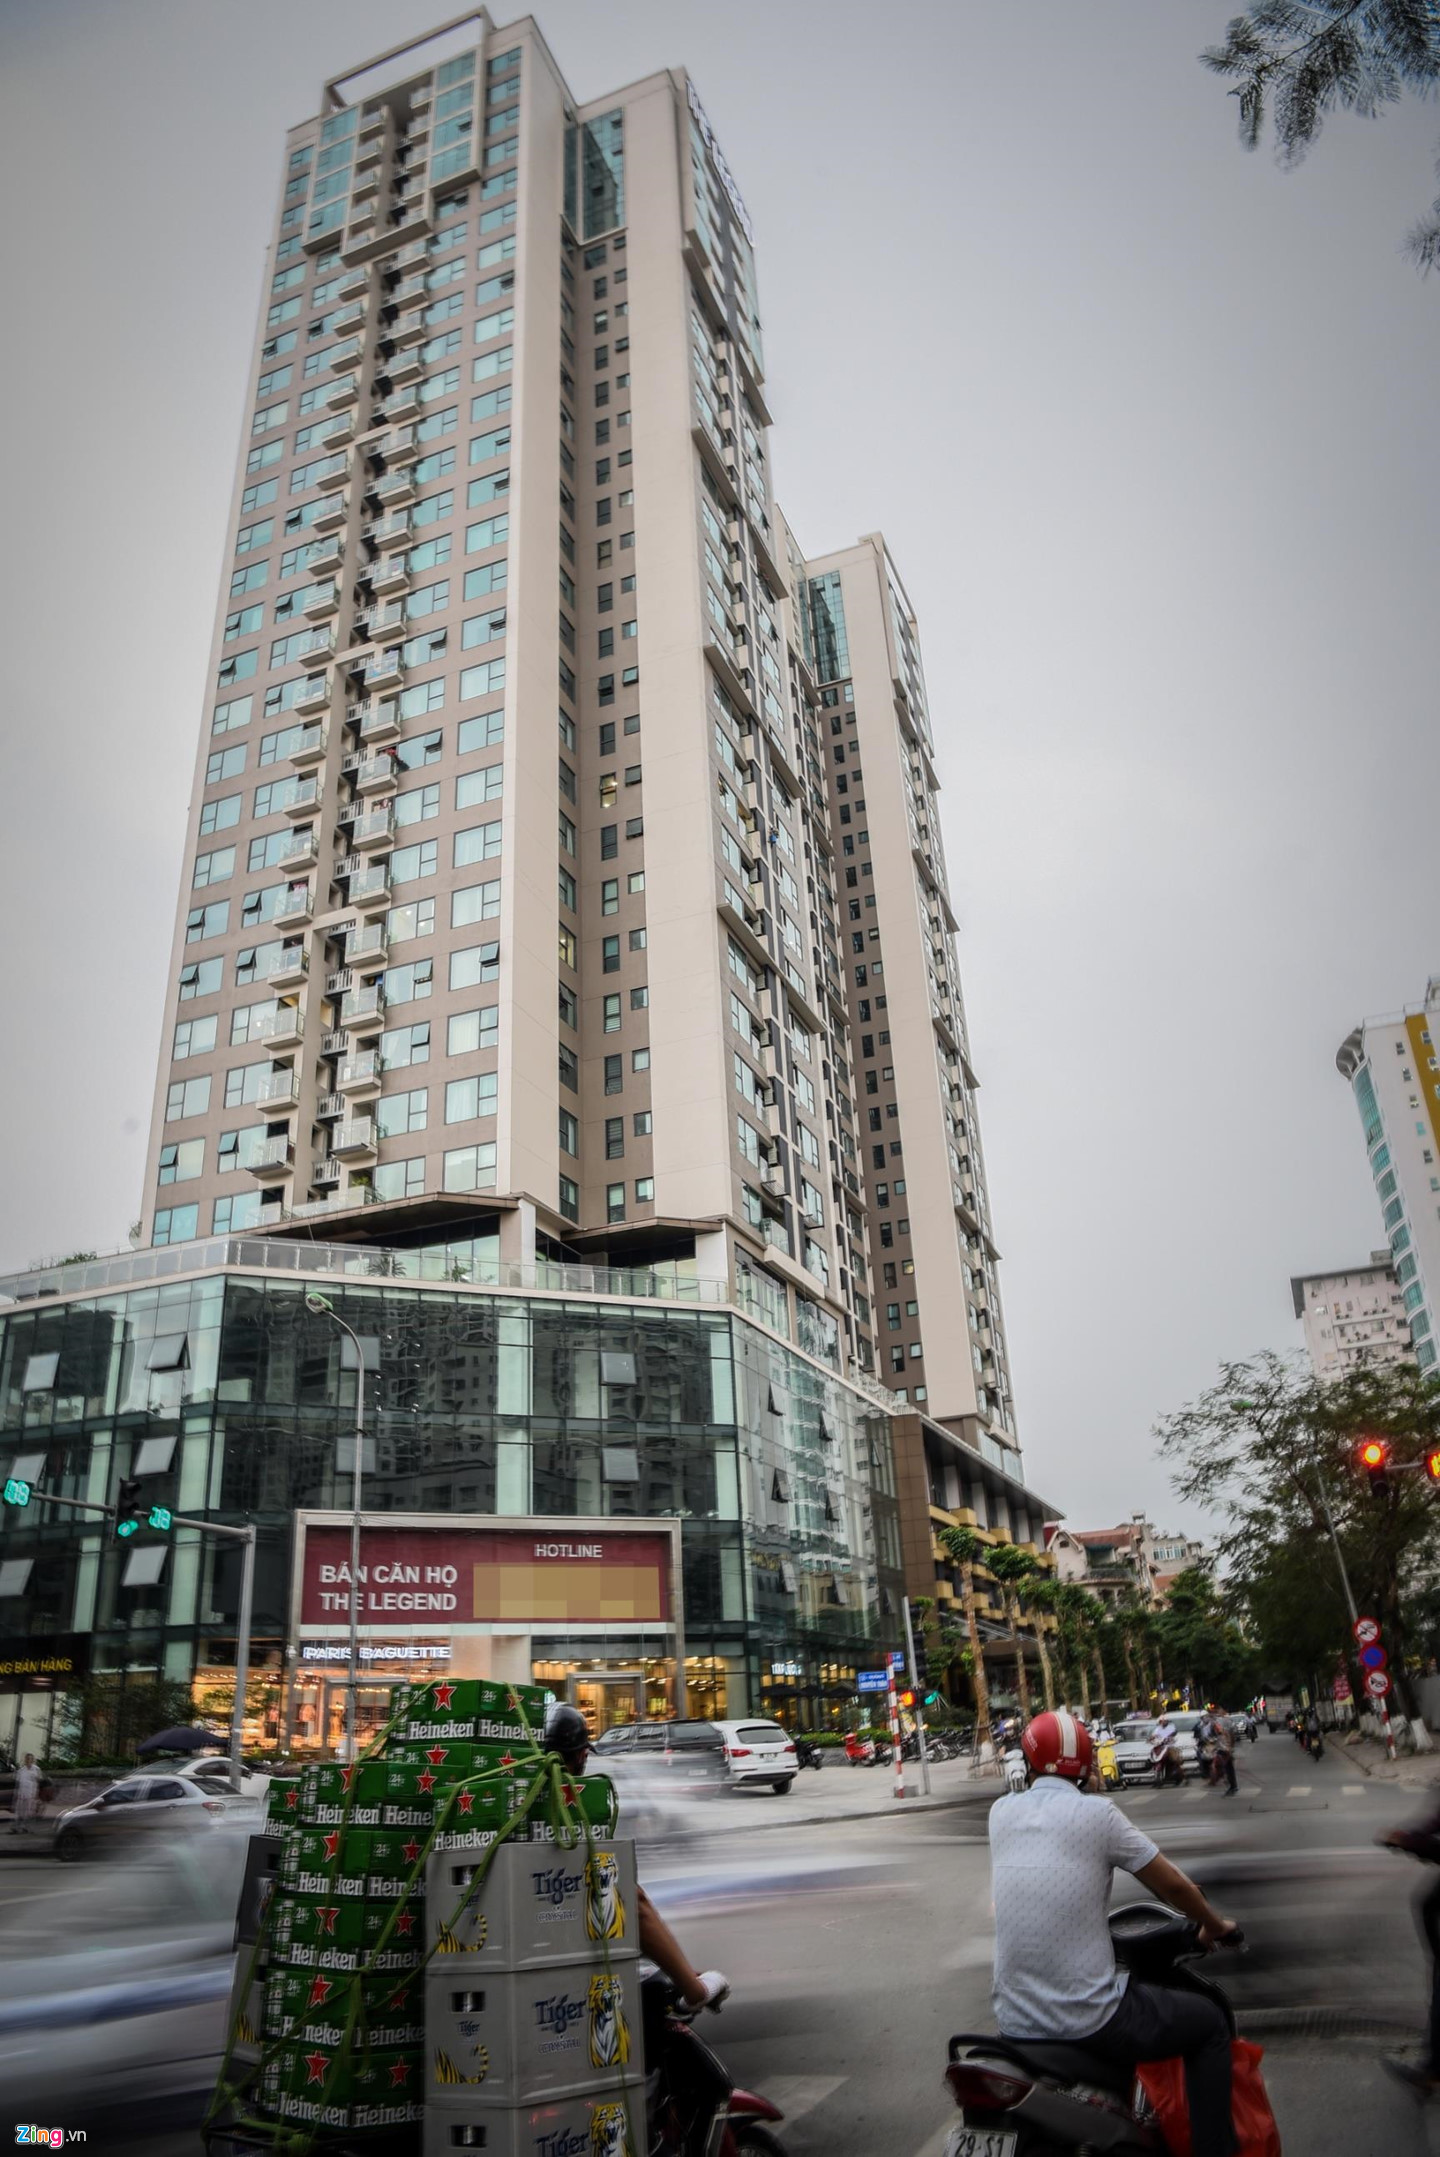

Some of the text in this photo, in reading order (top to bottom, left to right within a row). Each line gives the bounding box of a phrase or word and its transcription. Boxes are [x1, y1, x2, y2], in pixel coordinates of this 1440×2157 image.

[533, 1544, 603, 1558] HOTLINE
[372, 1562, 420, 1584] CĂN
[319, 1592, 457, 1611] THE LEGEND
[359, 1646, 452, 1659] BAGUETTE
[408, 1718, 475, 1741] Heineken
[530, 1866, 583, 1906] Tiger
[532, 1994, 587, 2034] Tiger
[458, 2020, 480, 2037] Tiger
